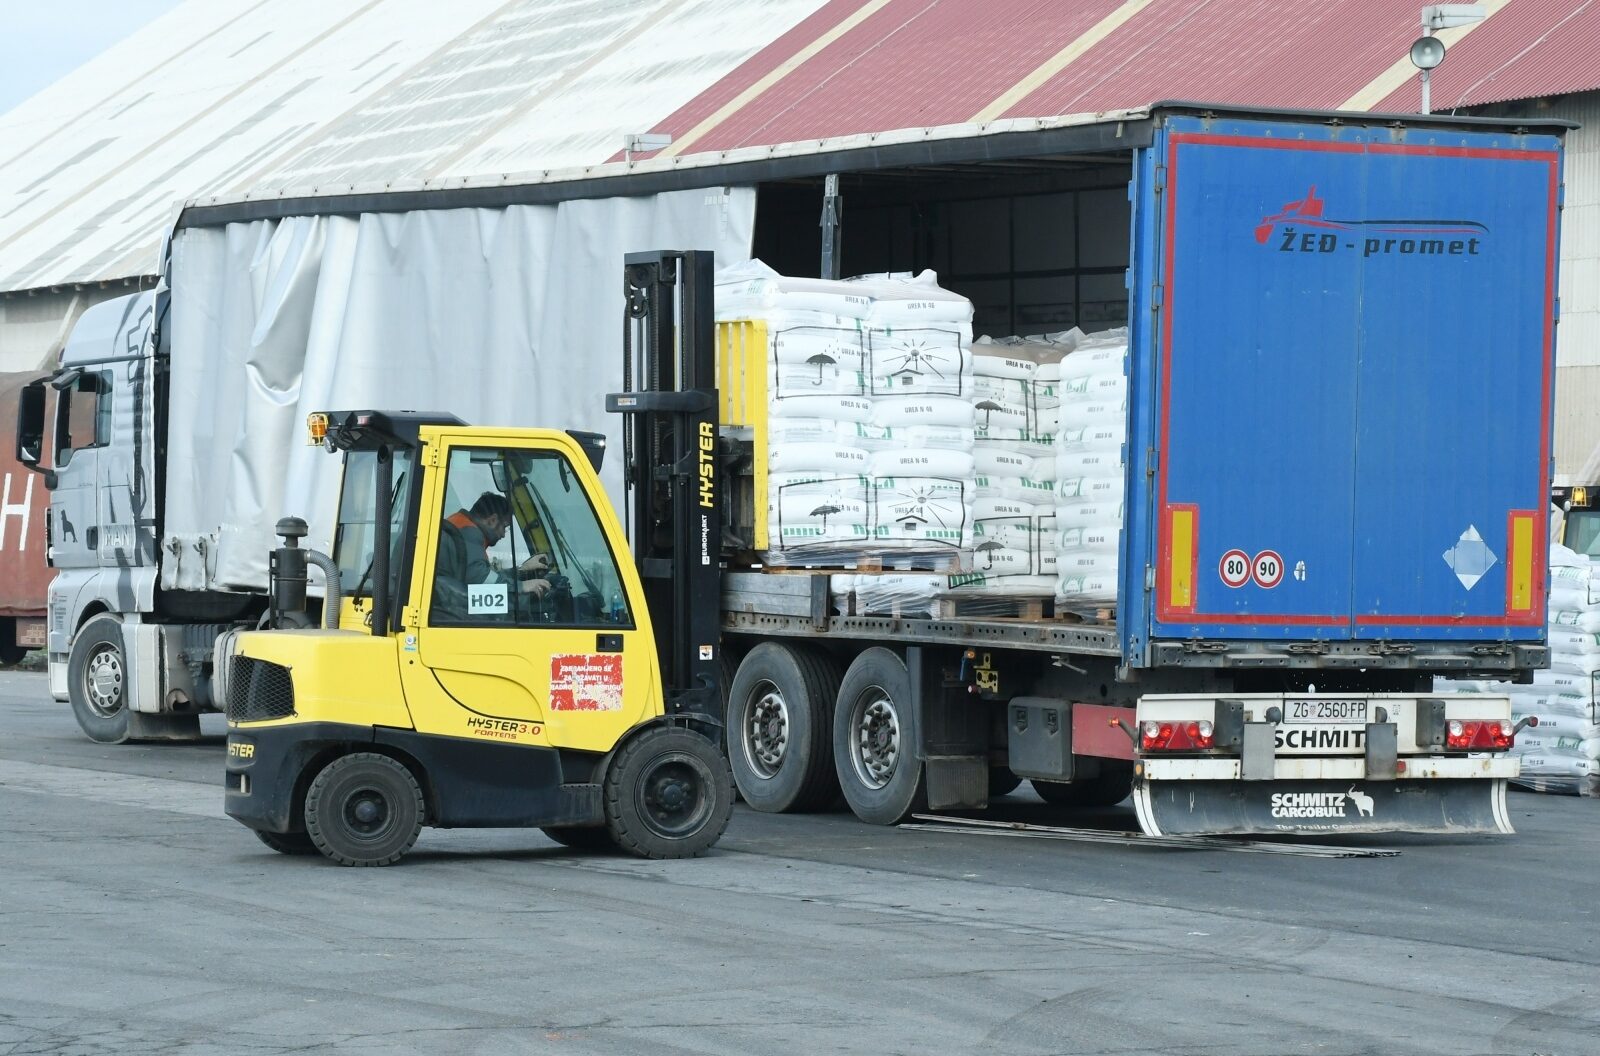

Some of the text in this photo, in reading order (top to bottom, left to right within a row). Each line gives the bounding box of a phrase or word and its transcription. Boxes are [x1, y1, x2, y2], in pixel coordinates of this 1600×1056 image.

[1279, 227, 1337, 253] ŽEĐ
[1363, 237, 1481, 258] promet
[1005, 359, 1019, 368] UREA
[840, 400, 855, 408] UREA
[699, 421, 714, 508] HYSTER
[0, 472, 35, 551] H
[105, 532, 130, 547] MAN
[1227, 560, 1243, 575] 80
[1260, 561, 1276, 576] 90
[471, 594, 505, 607] H02
[1293, 702, 1309, 718] ZG
[467, 717, 541, 735] HYSTER 3.0
[474, 729, 517, 739] FORTENS
[228, 742, 255, 758] STER
[1271, 793, 1346, 807] SCHMITZ
[1271, 806, 1346, 818] CARGOBULL
